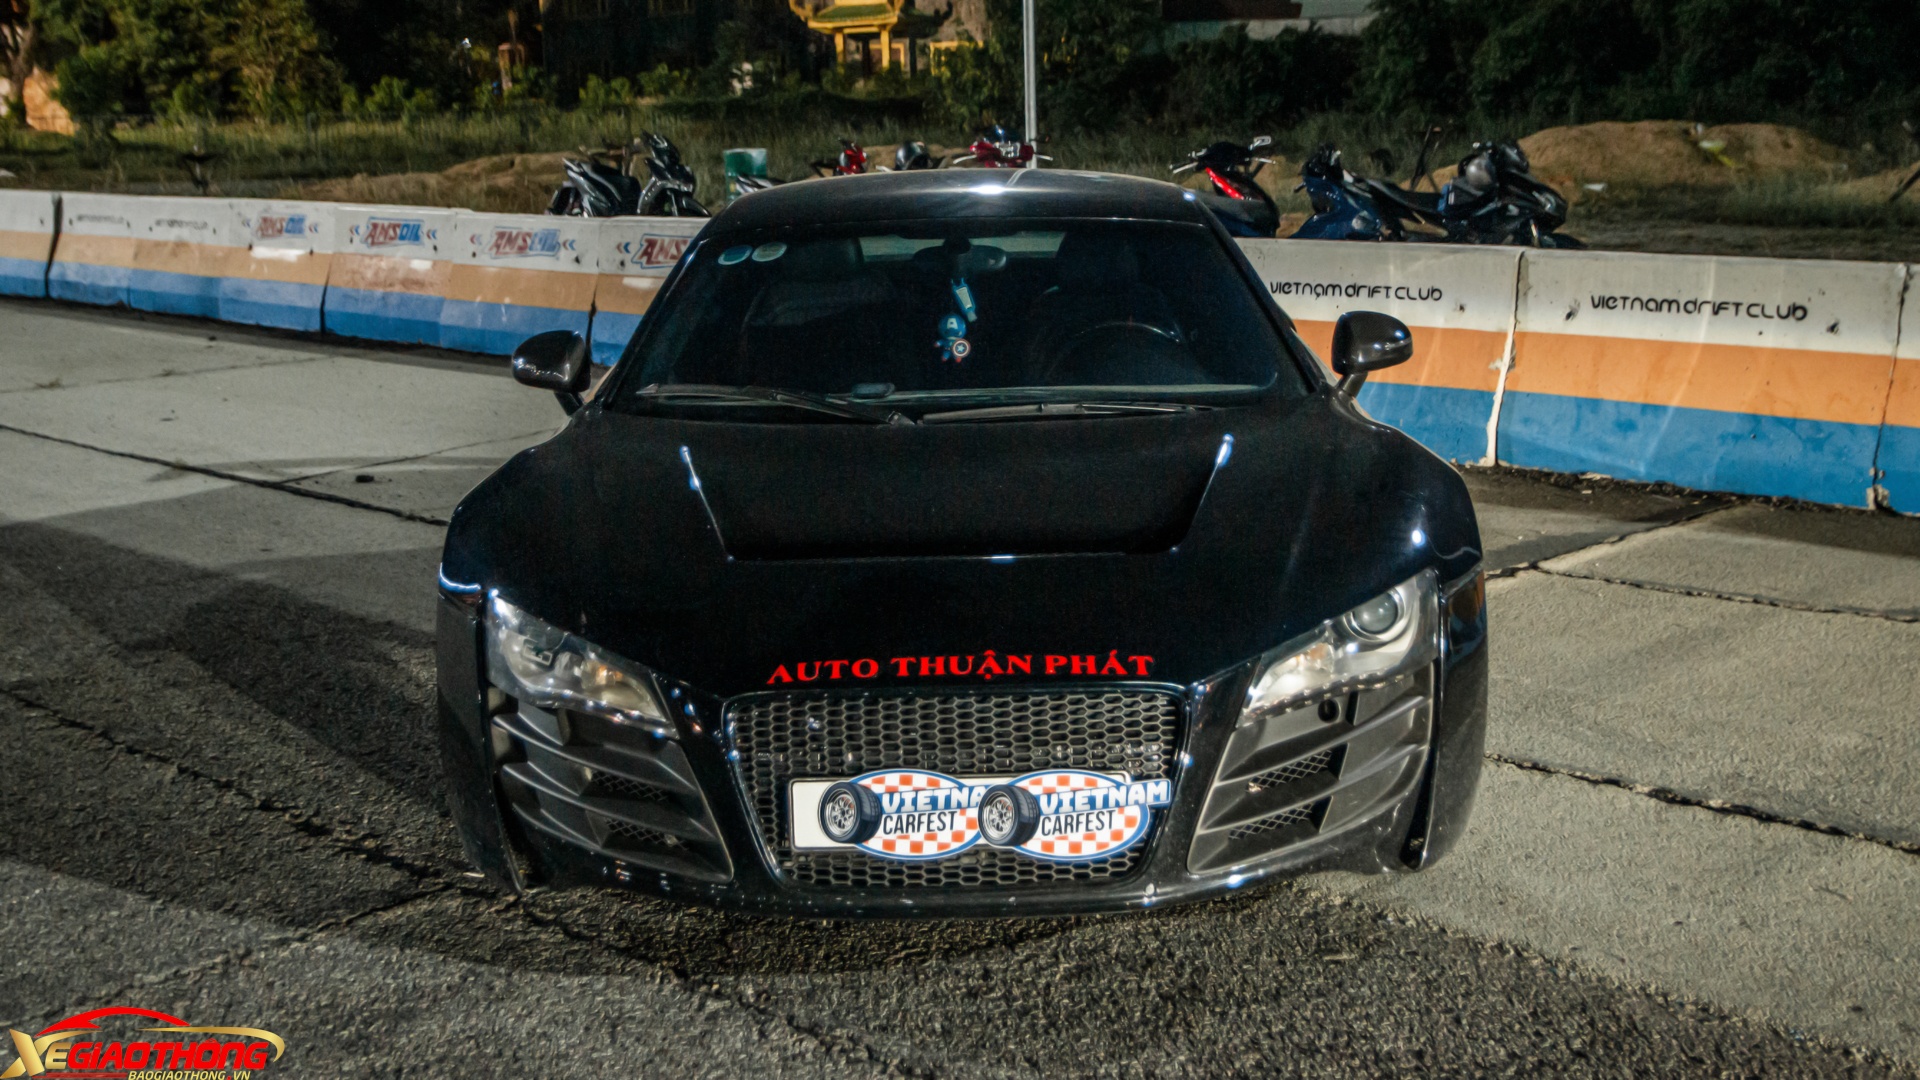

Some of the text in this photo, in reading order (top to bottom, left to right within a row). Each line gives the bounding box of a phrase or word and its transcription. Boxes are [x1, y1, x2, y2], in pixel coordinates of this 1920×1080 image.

[365, 220, 422, 247] AMSOIL
[489, 229, 559, 255] AMSOIL
[767, 650, 1153, 685] AUTO THUẬN PHÁT
